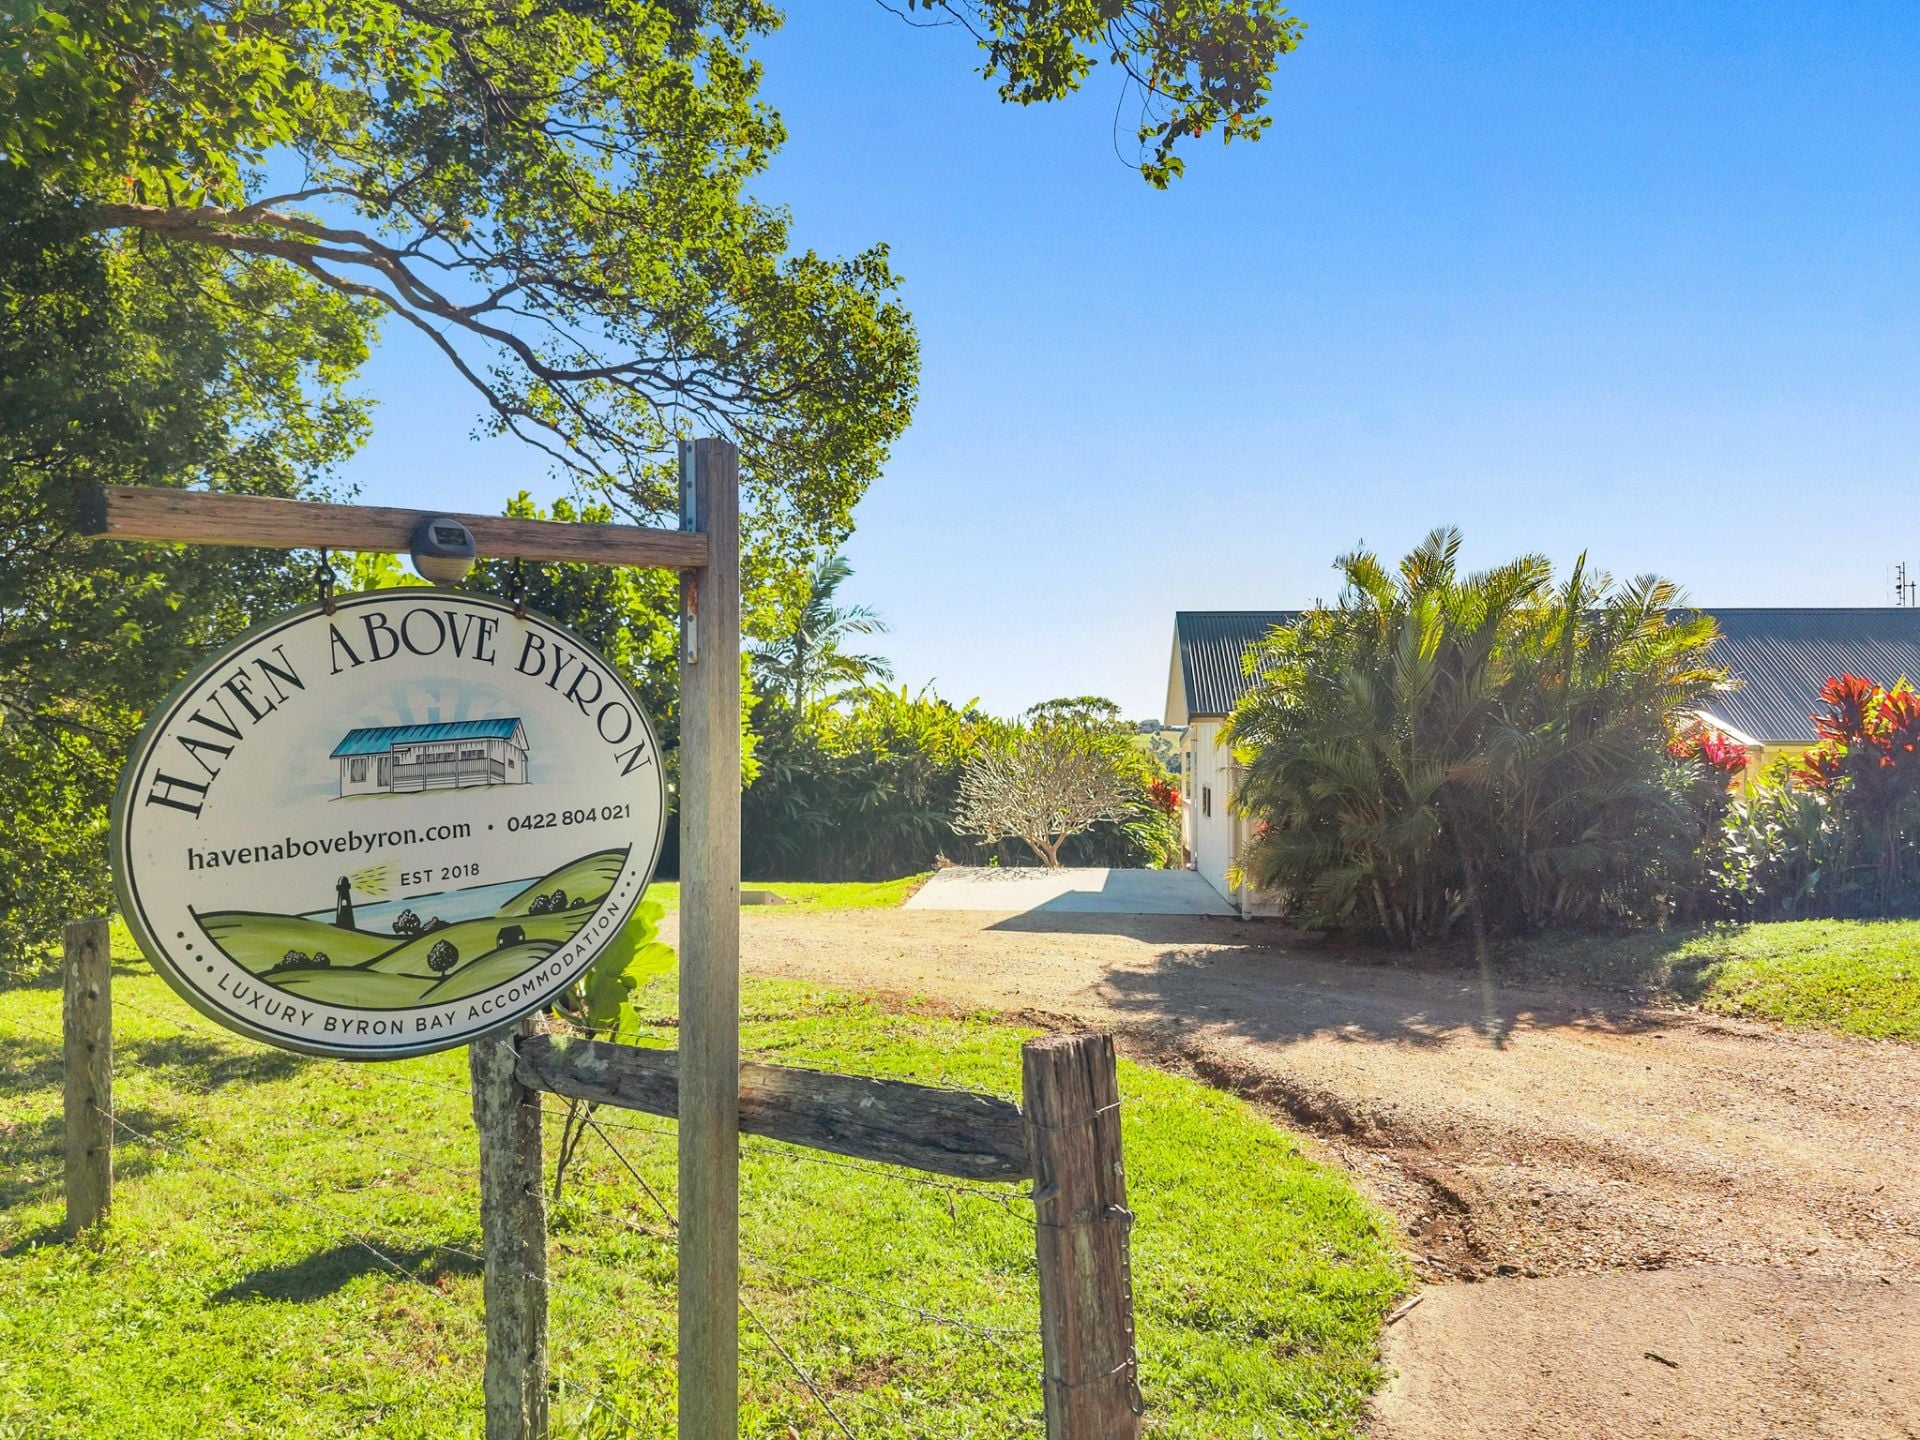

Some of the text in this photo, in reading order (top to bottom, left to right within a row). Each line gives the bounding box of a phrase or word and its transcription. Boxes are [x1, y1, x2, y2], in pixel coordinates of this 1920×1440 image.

[145, 608, 655, 820] HAVEN ABOVE BYRON
[187, 804, 631, 871] havenabovebyron.com 0422 804 021
[400, 863, 480, 886] EST 2018
[216, 901, 620, 1035] LUXURY BYRON BAY ACCOMMODATION
